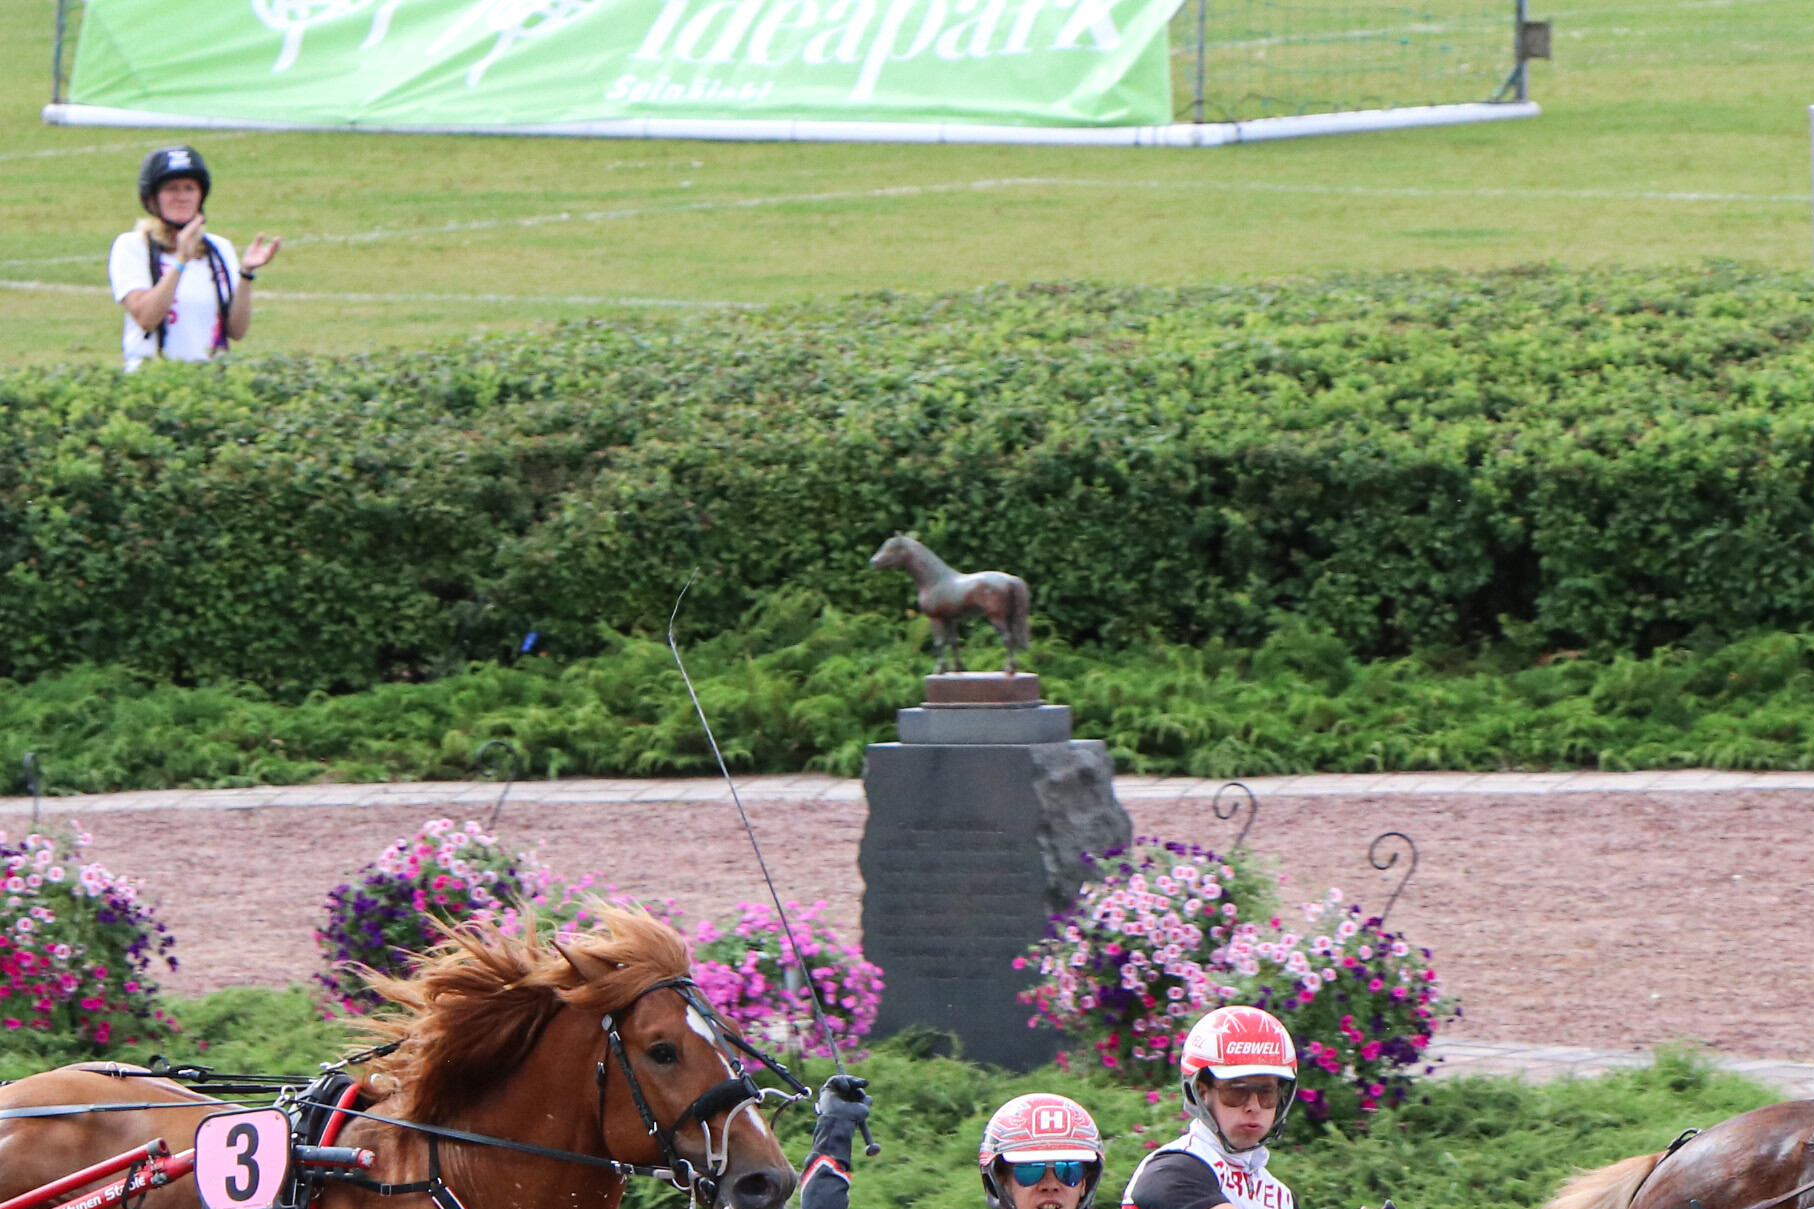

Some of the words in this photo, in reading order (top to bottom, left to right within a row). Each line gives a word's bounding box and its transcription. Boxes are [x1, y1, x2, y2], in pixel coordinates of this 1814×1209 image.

[1226, 1041, 1280, 1055] GEBWELL
[1040, 1110, 1063, 1130] H
[225, 1122, 260, 1202] 3
